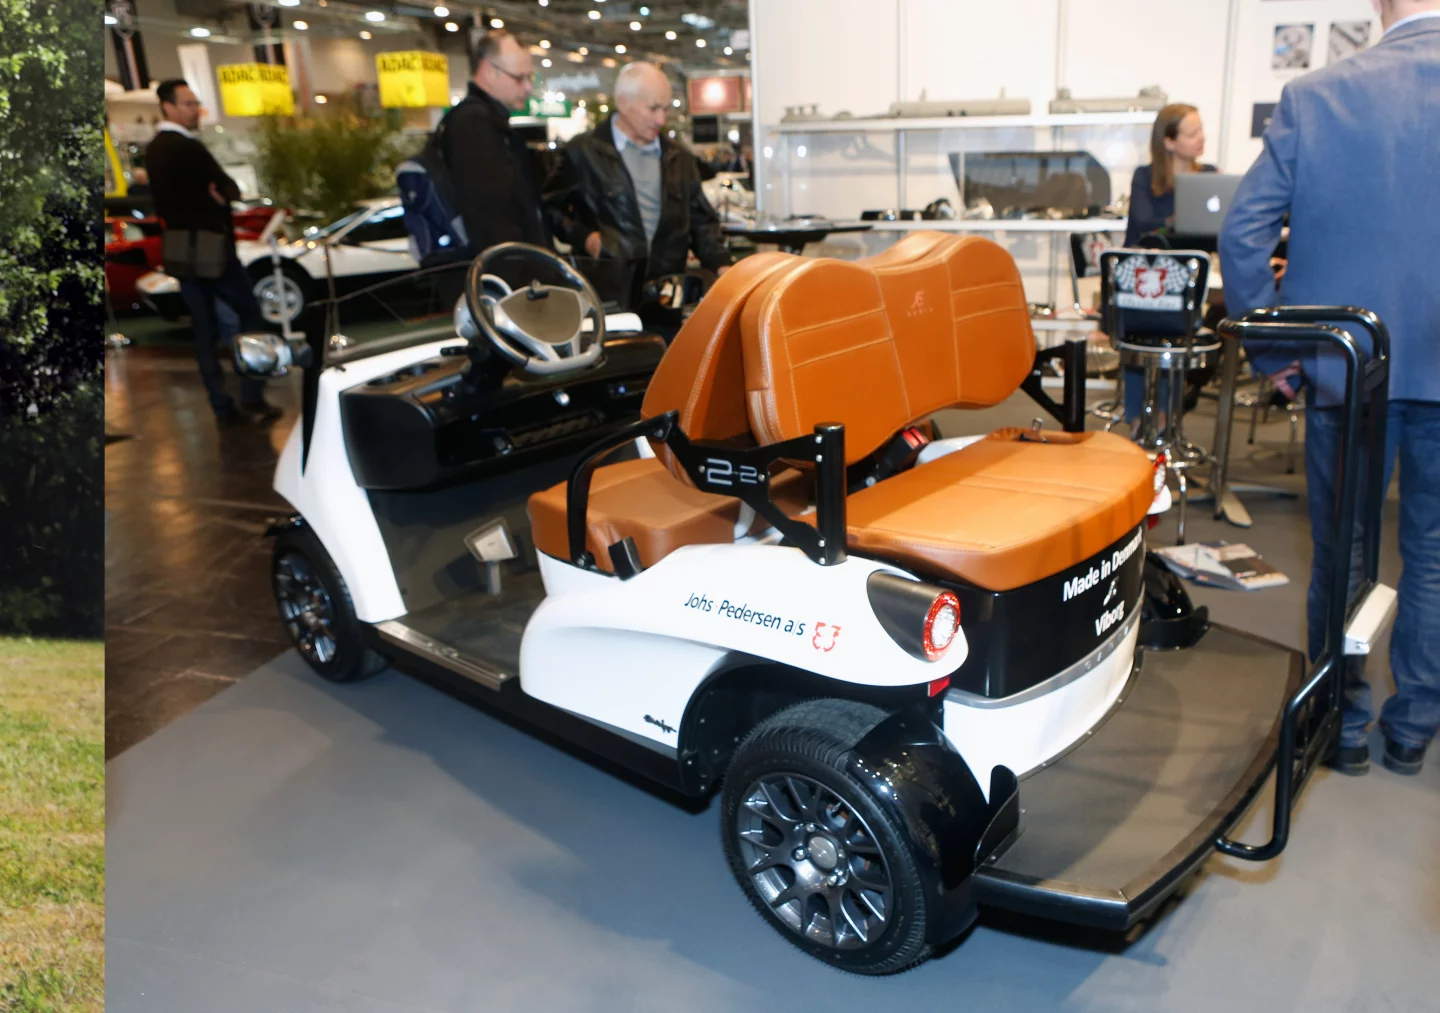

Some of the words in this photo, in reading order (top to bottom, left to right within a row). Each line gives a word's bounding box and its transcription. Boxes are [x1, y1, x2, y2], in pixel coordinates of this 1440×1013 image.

[1063, 566, 1100, 602] Made
[1100, 559, 1112, 580] in
[684, 592, 714, 613] Johs
[718, 599, 782, 630] Pedersen
[1095, 600, 1125, 637] Viborg
